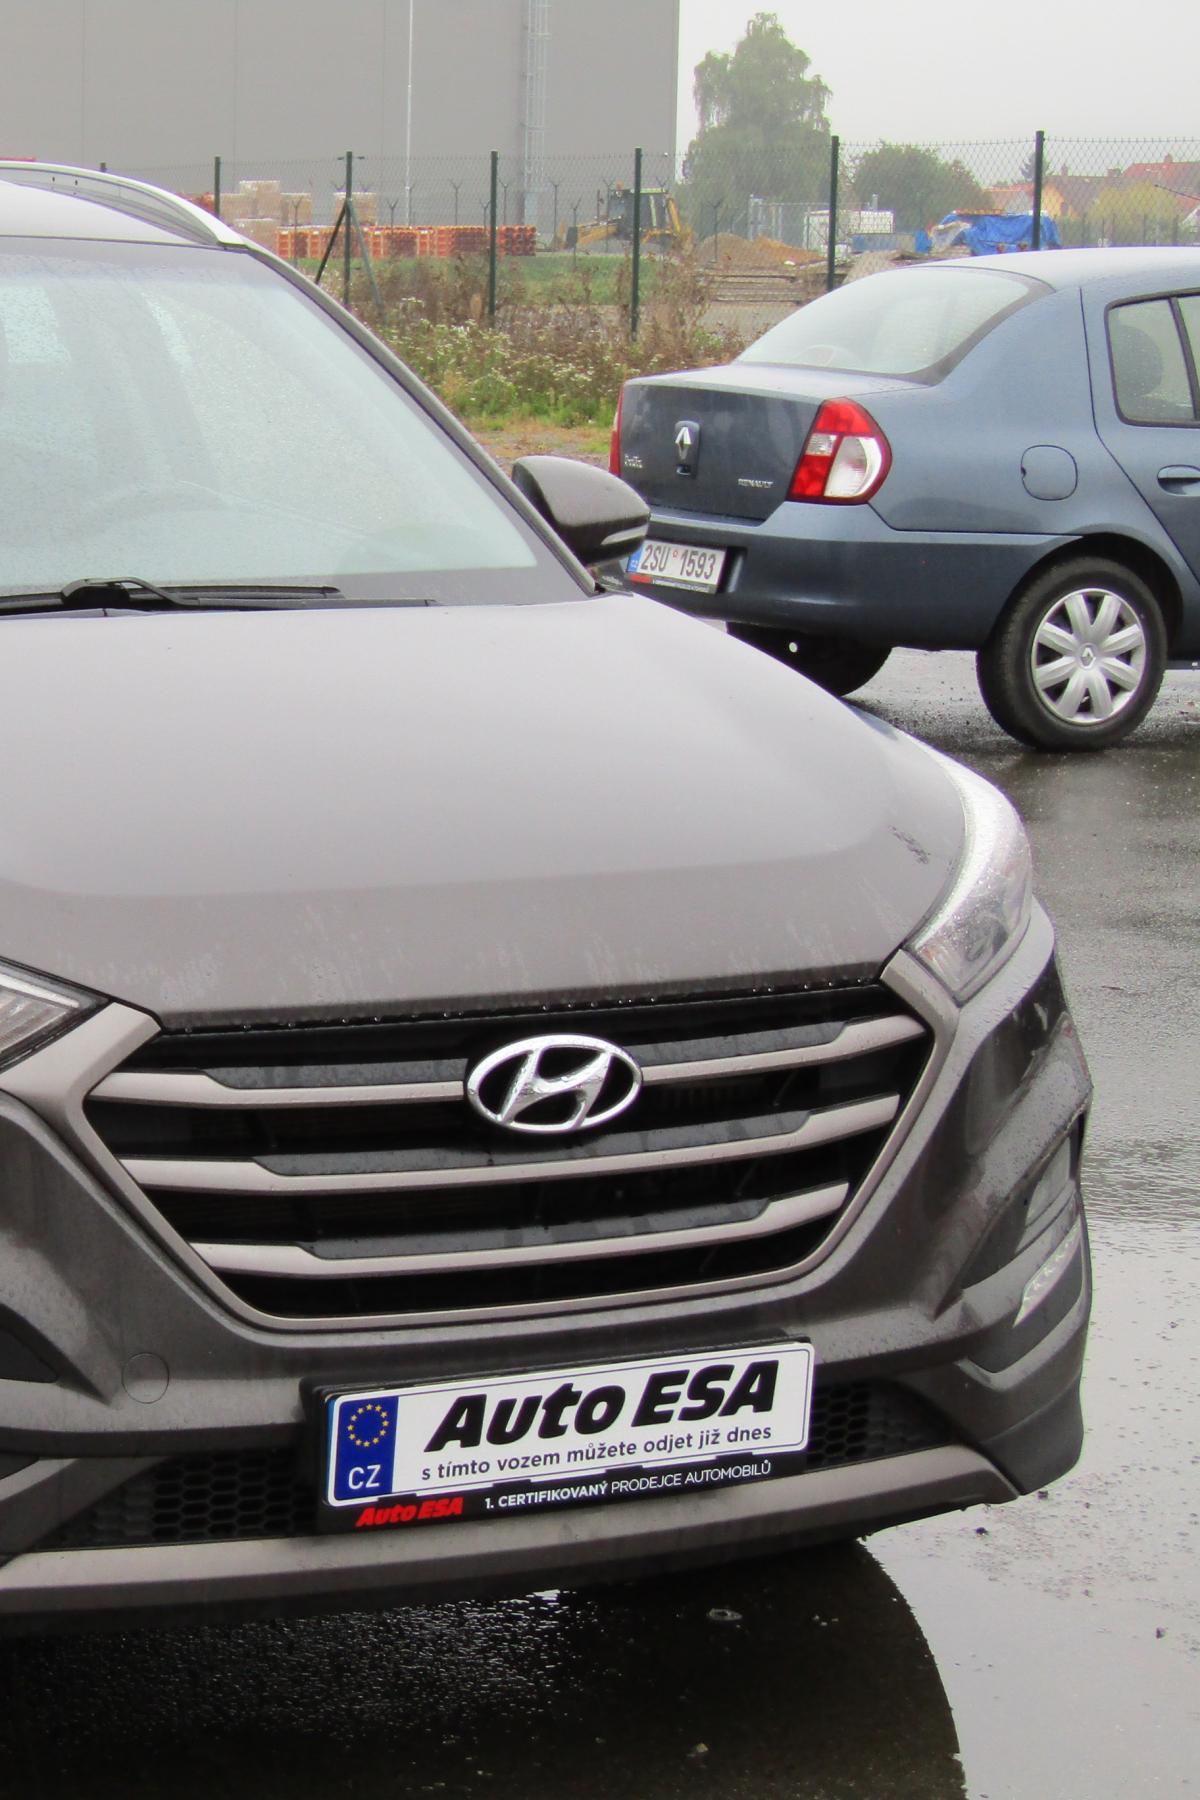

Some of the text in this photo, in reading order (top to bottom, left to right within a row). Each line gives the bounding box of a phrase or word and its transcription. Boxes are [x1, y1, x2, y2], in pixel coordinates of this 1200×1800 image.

[640, 544, 716, 580] 2SU 1593
[424, 1360, 780, 1453] Auto ESA
[421, 1426, 772, 1480] s tímto vozem můžete odjet již dnes
[348, 1464, 381, 1490] CZ
[484, 1459, 772, 1510] 1. CERTIFIKOVANÝ PRODEJCE AUTOMOBILŮ
[356, 1497, 464, 1527] Auto ESA
